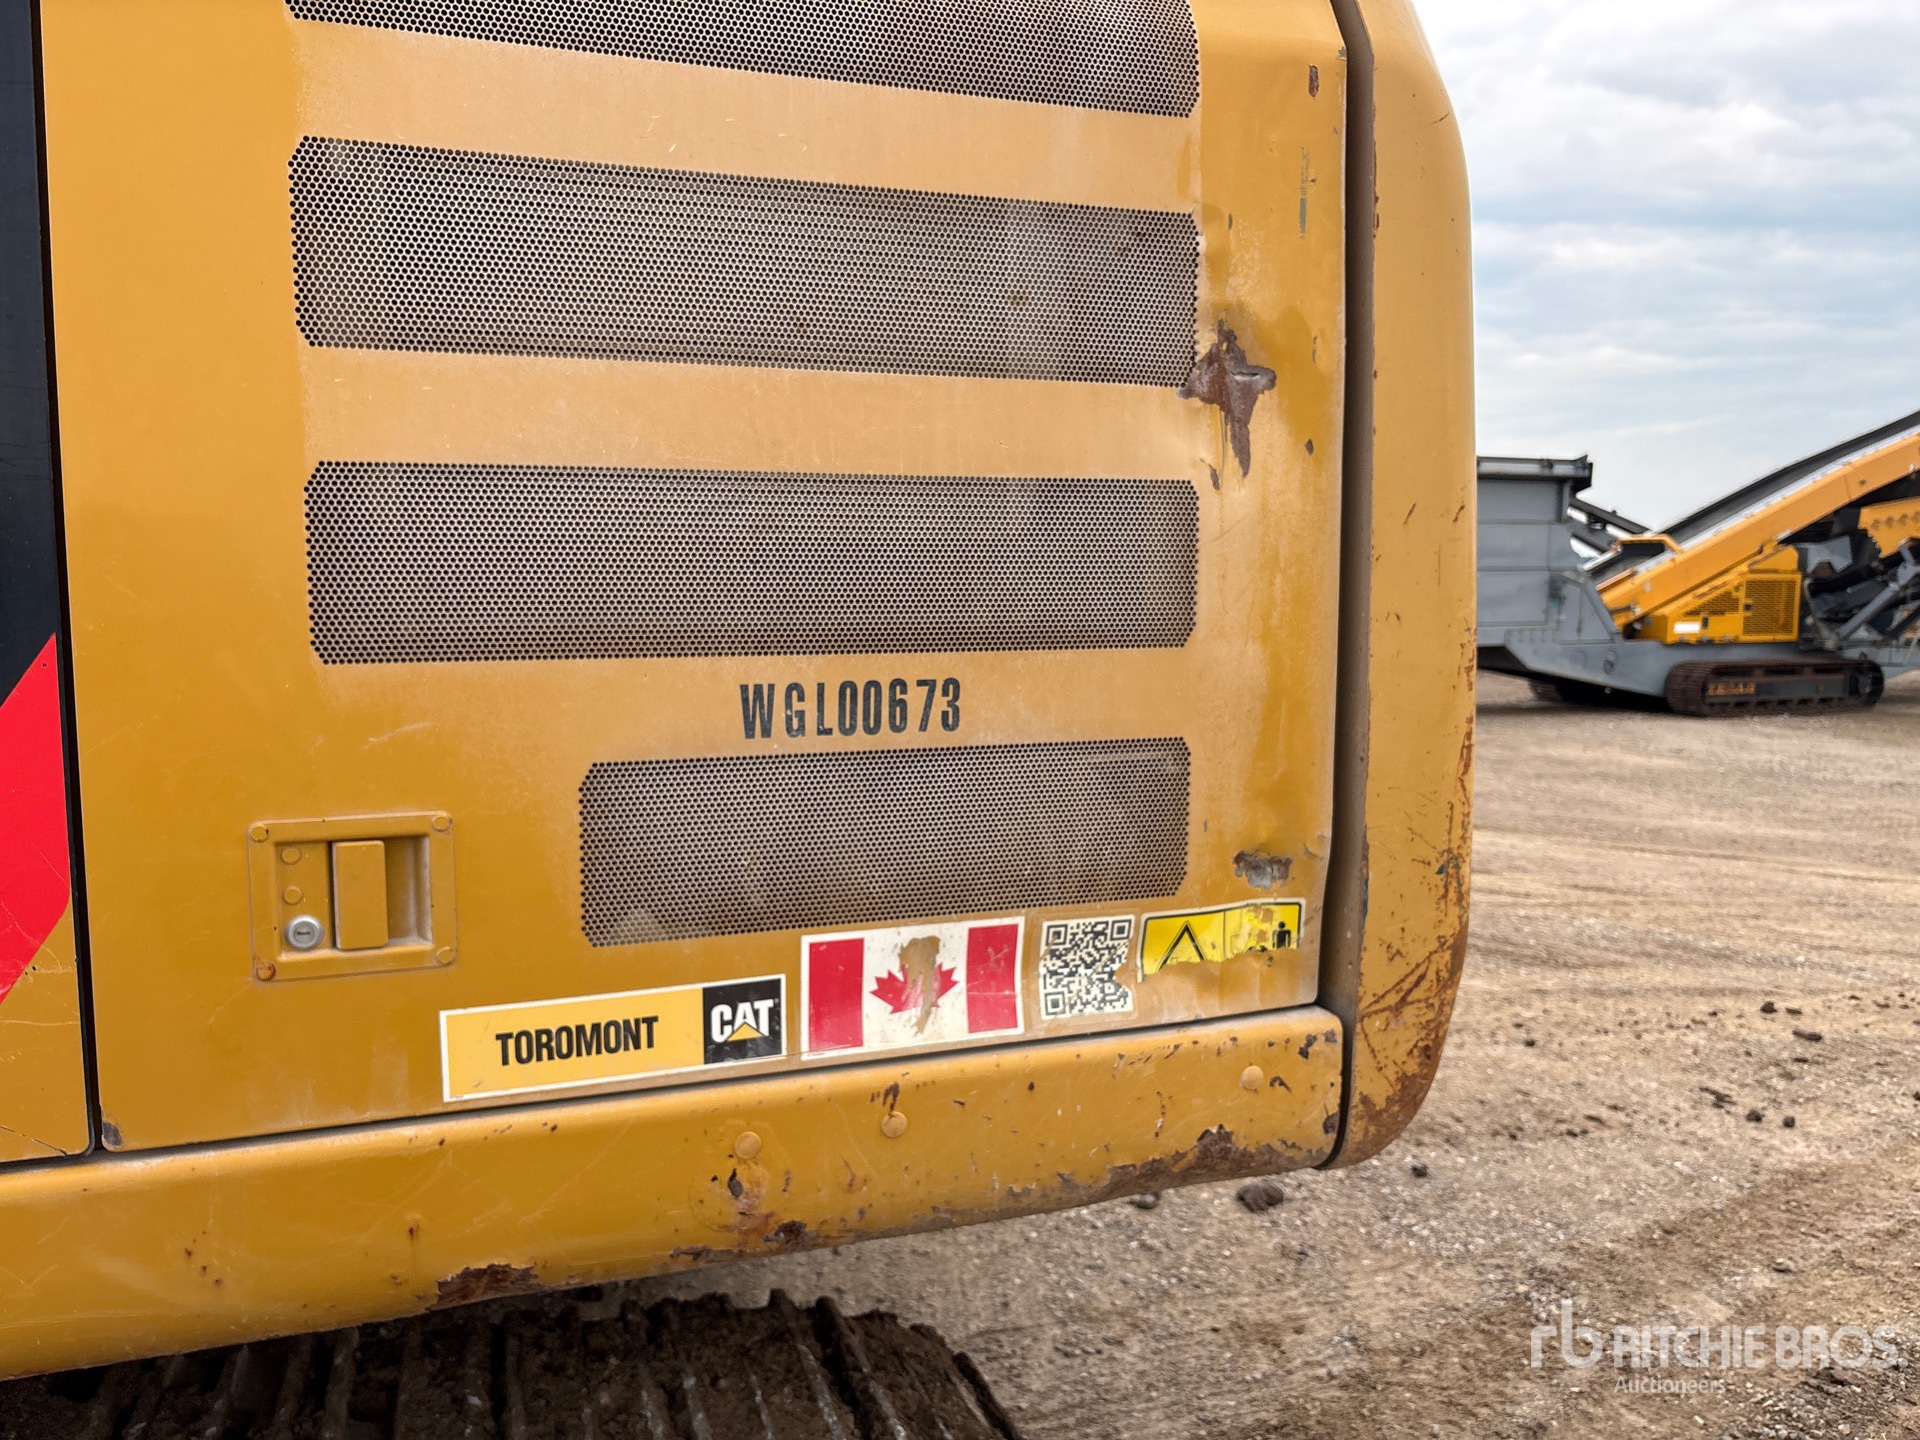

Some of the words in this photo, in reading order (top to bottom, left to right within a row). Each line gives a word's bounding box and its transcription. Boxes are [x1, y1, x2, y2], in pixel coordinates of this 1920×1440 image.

[740, 678, 960, 739] WGL00673
[496, 1015, 659, 1066] TOROMONT
[711, 999, 774, 1043] CAT
